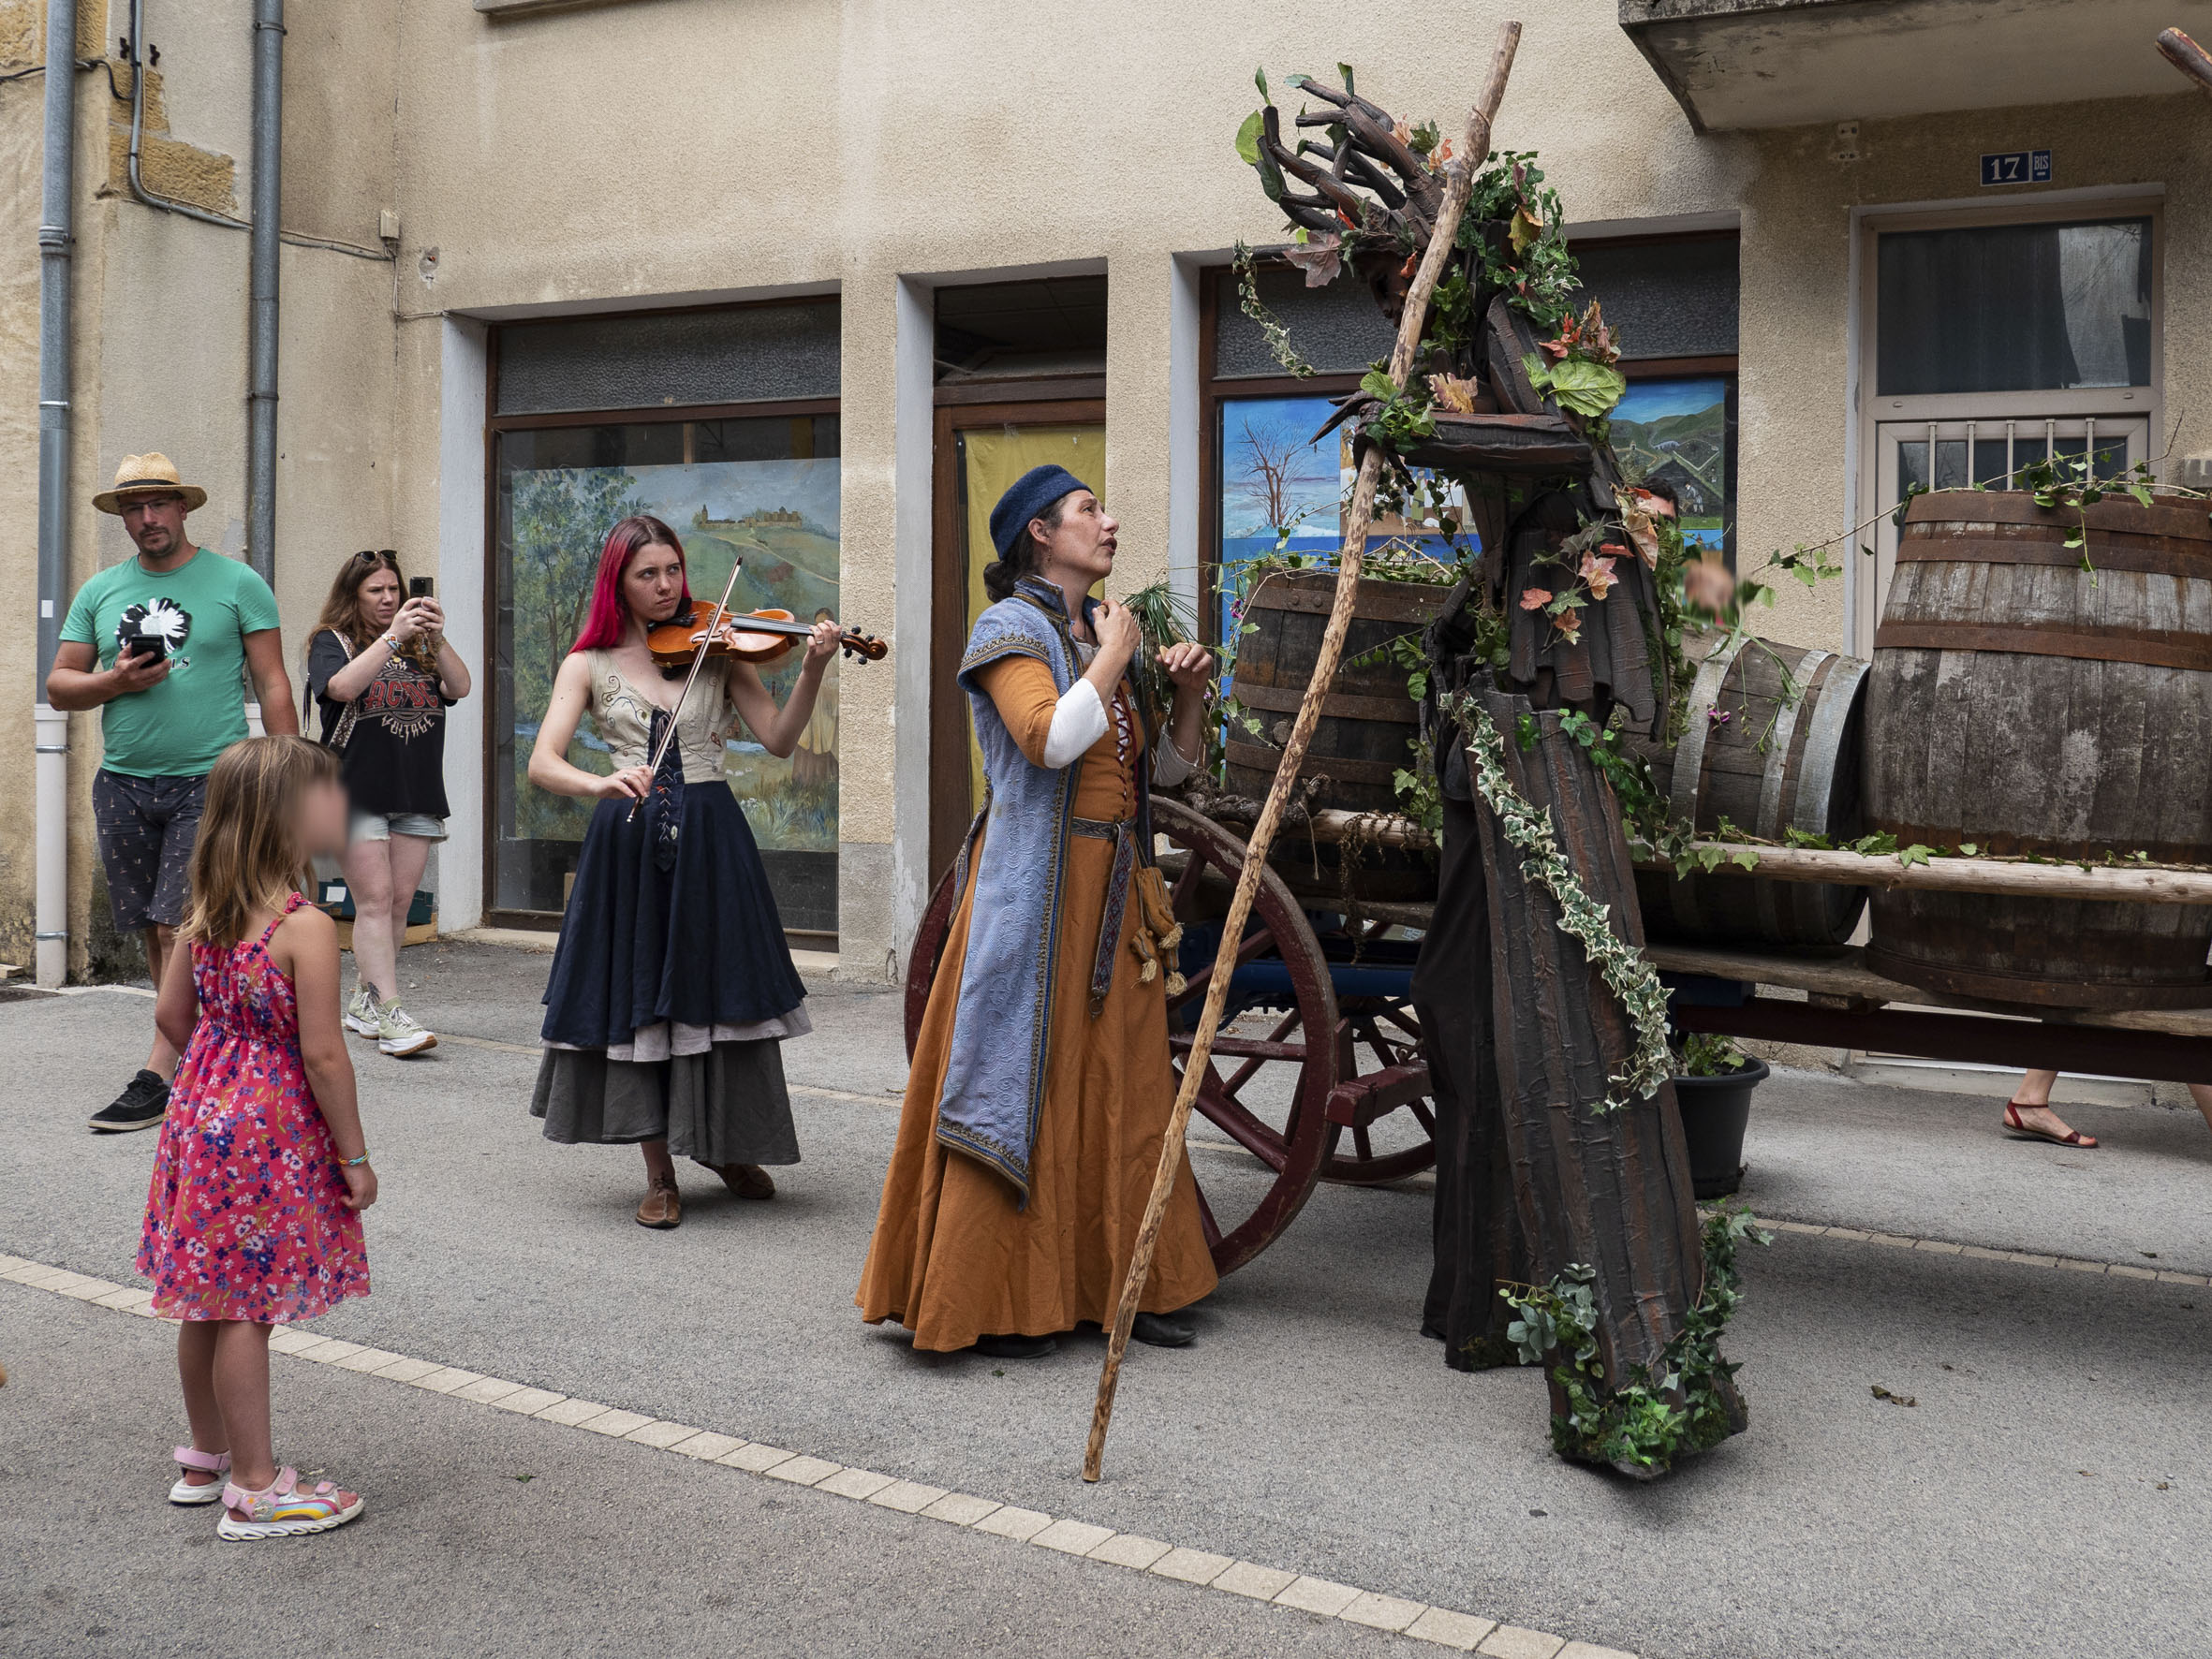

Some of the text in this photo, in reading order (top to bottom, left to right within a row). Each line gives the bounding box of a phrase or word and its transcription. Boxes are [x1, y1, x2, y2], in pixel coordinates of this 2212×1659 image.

[1991, 154, 2049, 181] 17 BIS
[381, 713, 435, 745] VOLTAGE
